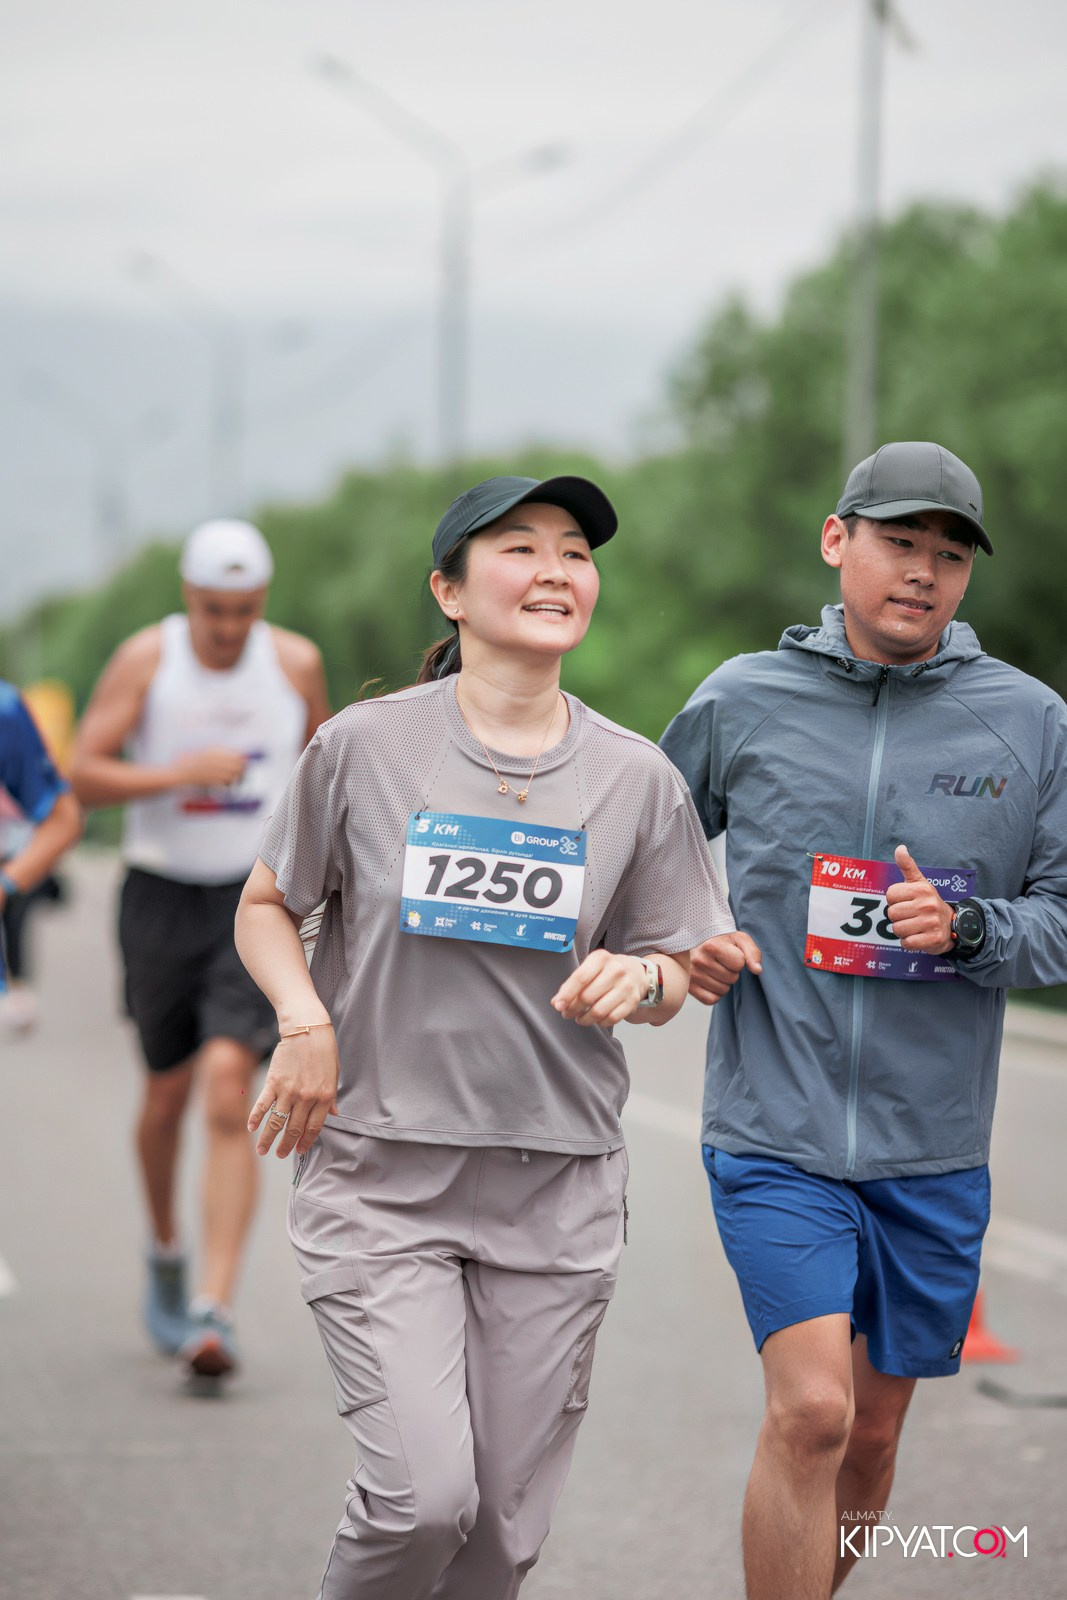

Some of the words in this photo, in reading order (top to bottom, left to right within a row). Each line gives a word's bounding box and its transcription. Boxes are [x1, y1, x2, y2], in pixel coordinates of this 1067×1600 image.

[924, 774, 1008, 798] RUN
[416, 819, 431, 833] 5
[526, 836, 560, 848] GROUP
[820, 860, 841, 876] 10
[424, 854, 563, 909] 1250
[927, 878, 950, 886] ROUP
